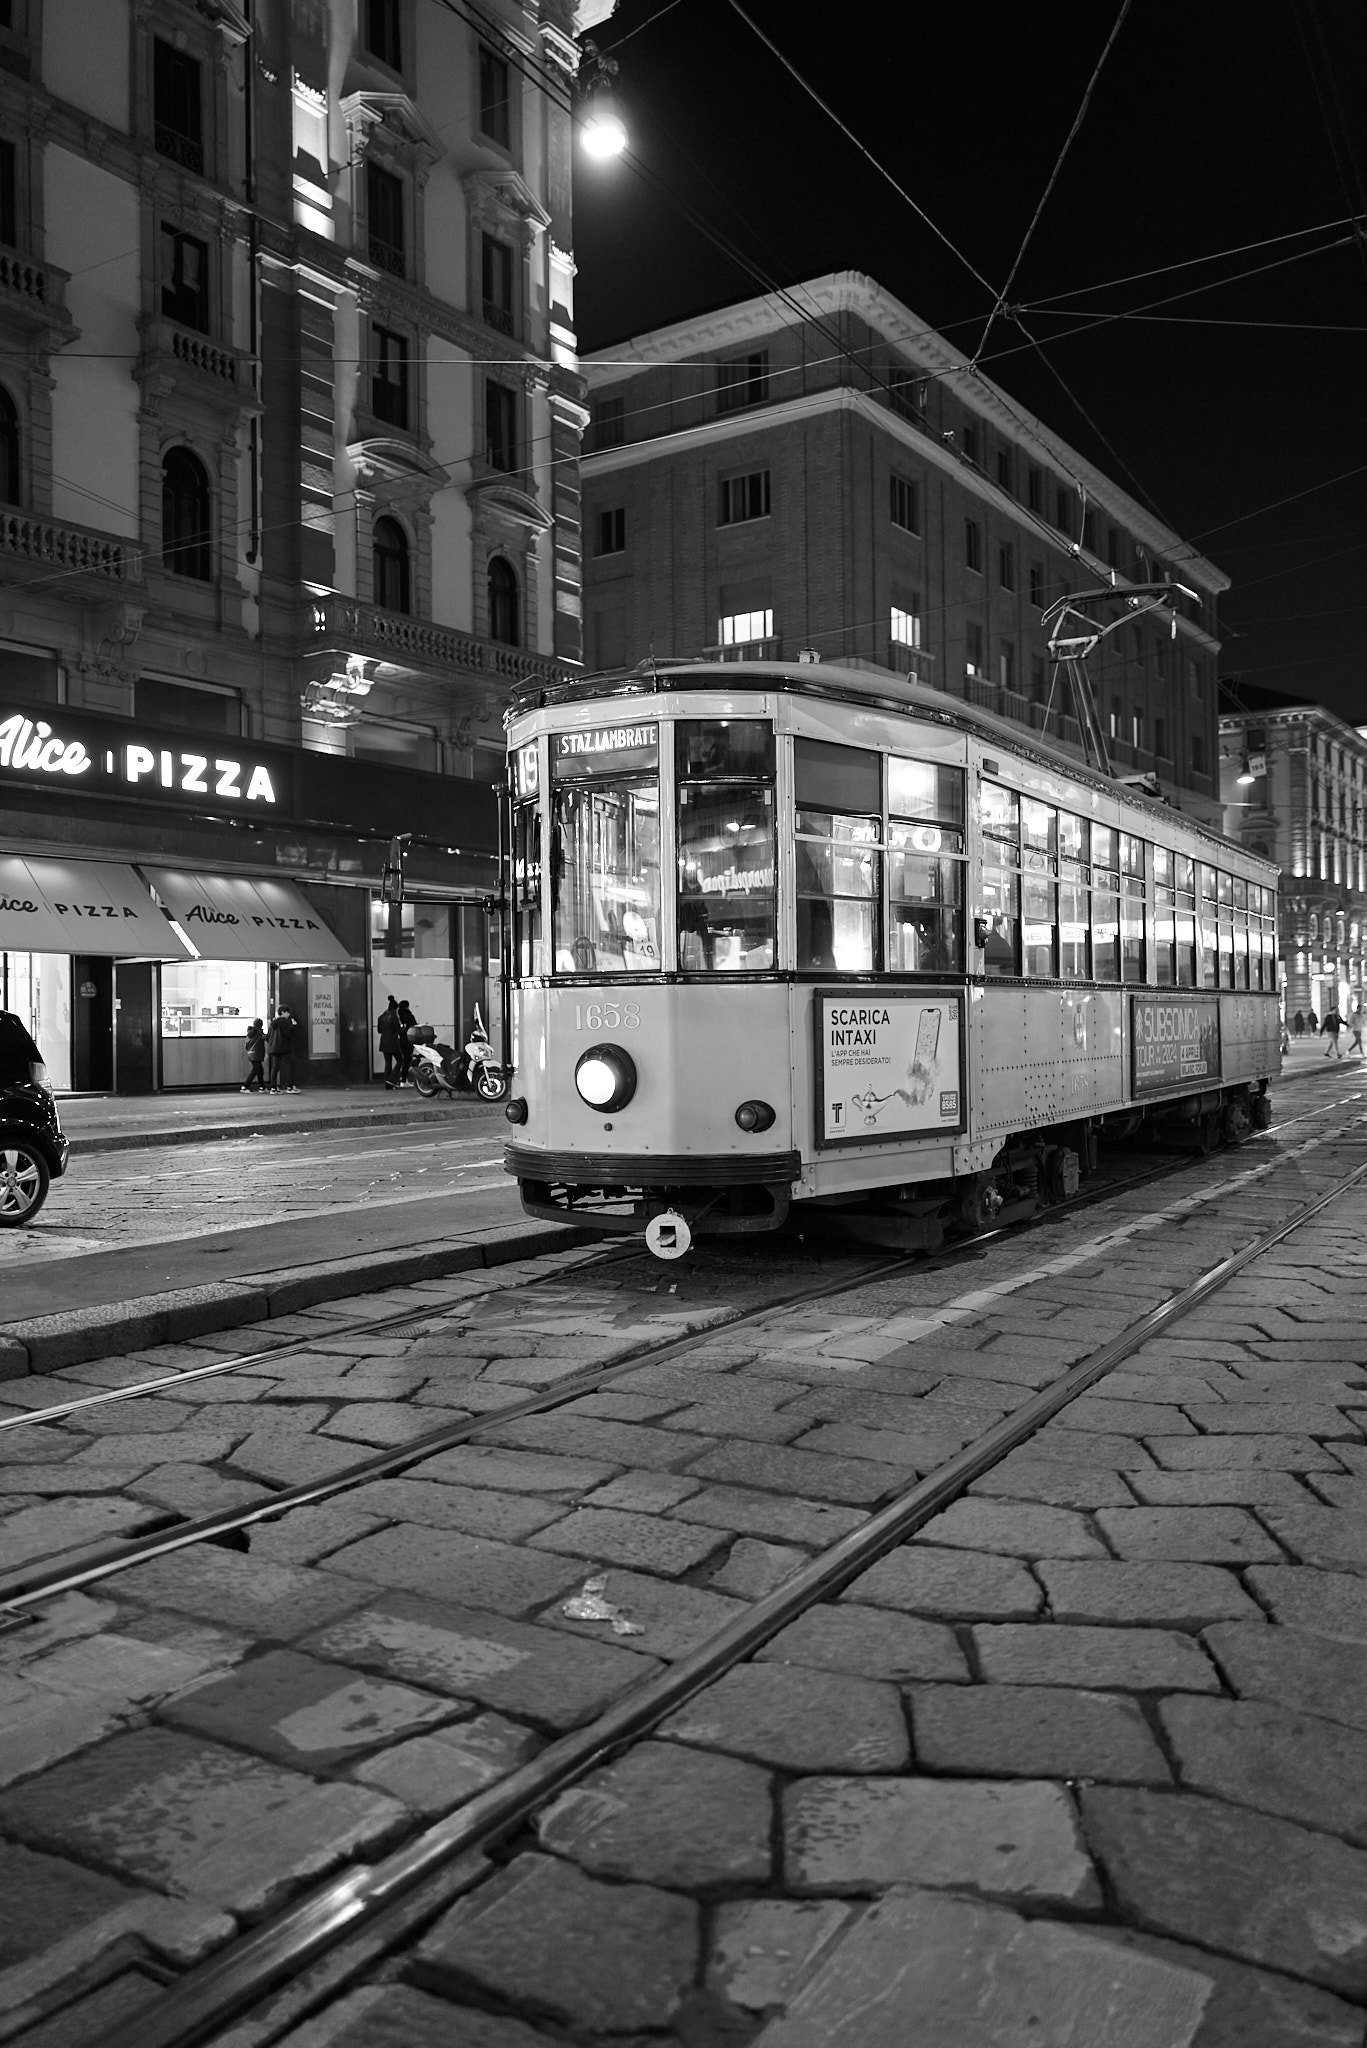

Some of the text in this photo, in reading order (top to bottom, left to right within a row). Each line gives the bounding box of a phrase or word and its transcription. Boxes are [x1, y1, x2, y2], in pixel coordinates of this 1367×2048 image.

[0, 714, 276, 803] Alice PIZZA
[519, 744, 538, 794] 19
[54, 903, 139, 919] PIZZA
[185, 905, 320, 930] Alice PIZZA
[575, 1002, 641, 1031] 1658
[831, 1009, 891, 1025] SCARICA
[1144, 1007, 1201, 1043] SUBSONICA
[831, 1029, 876, 1046] INTAXI
[831, 1048, 871, 1058] L'APP CHE HAI
[831, 1058, 854, 1067] SEMPRE
[1135, 1045, 1155, 1067] TOUR
[941, 1100, 957, 1110] 8585
